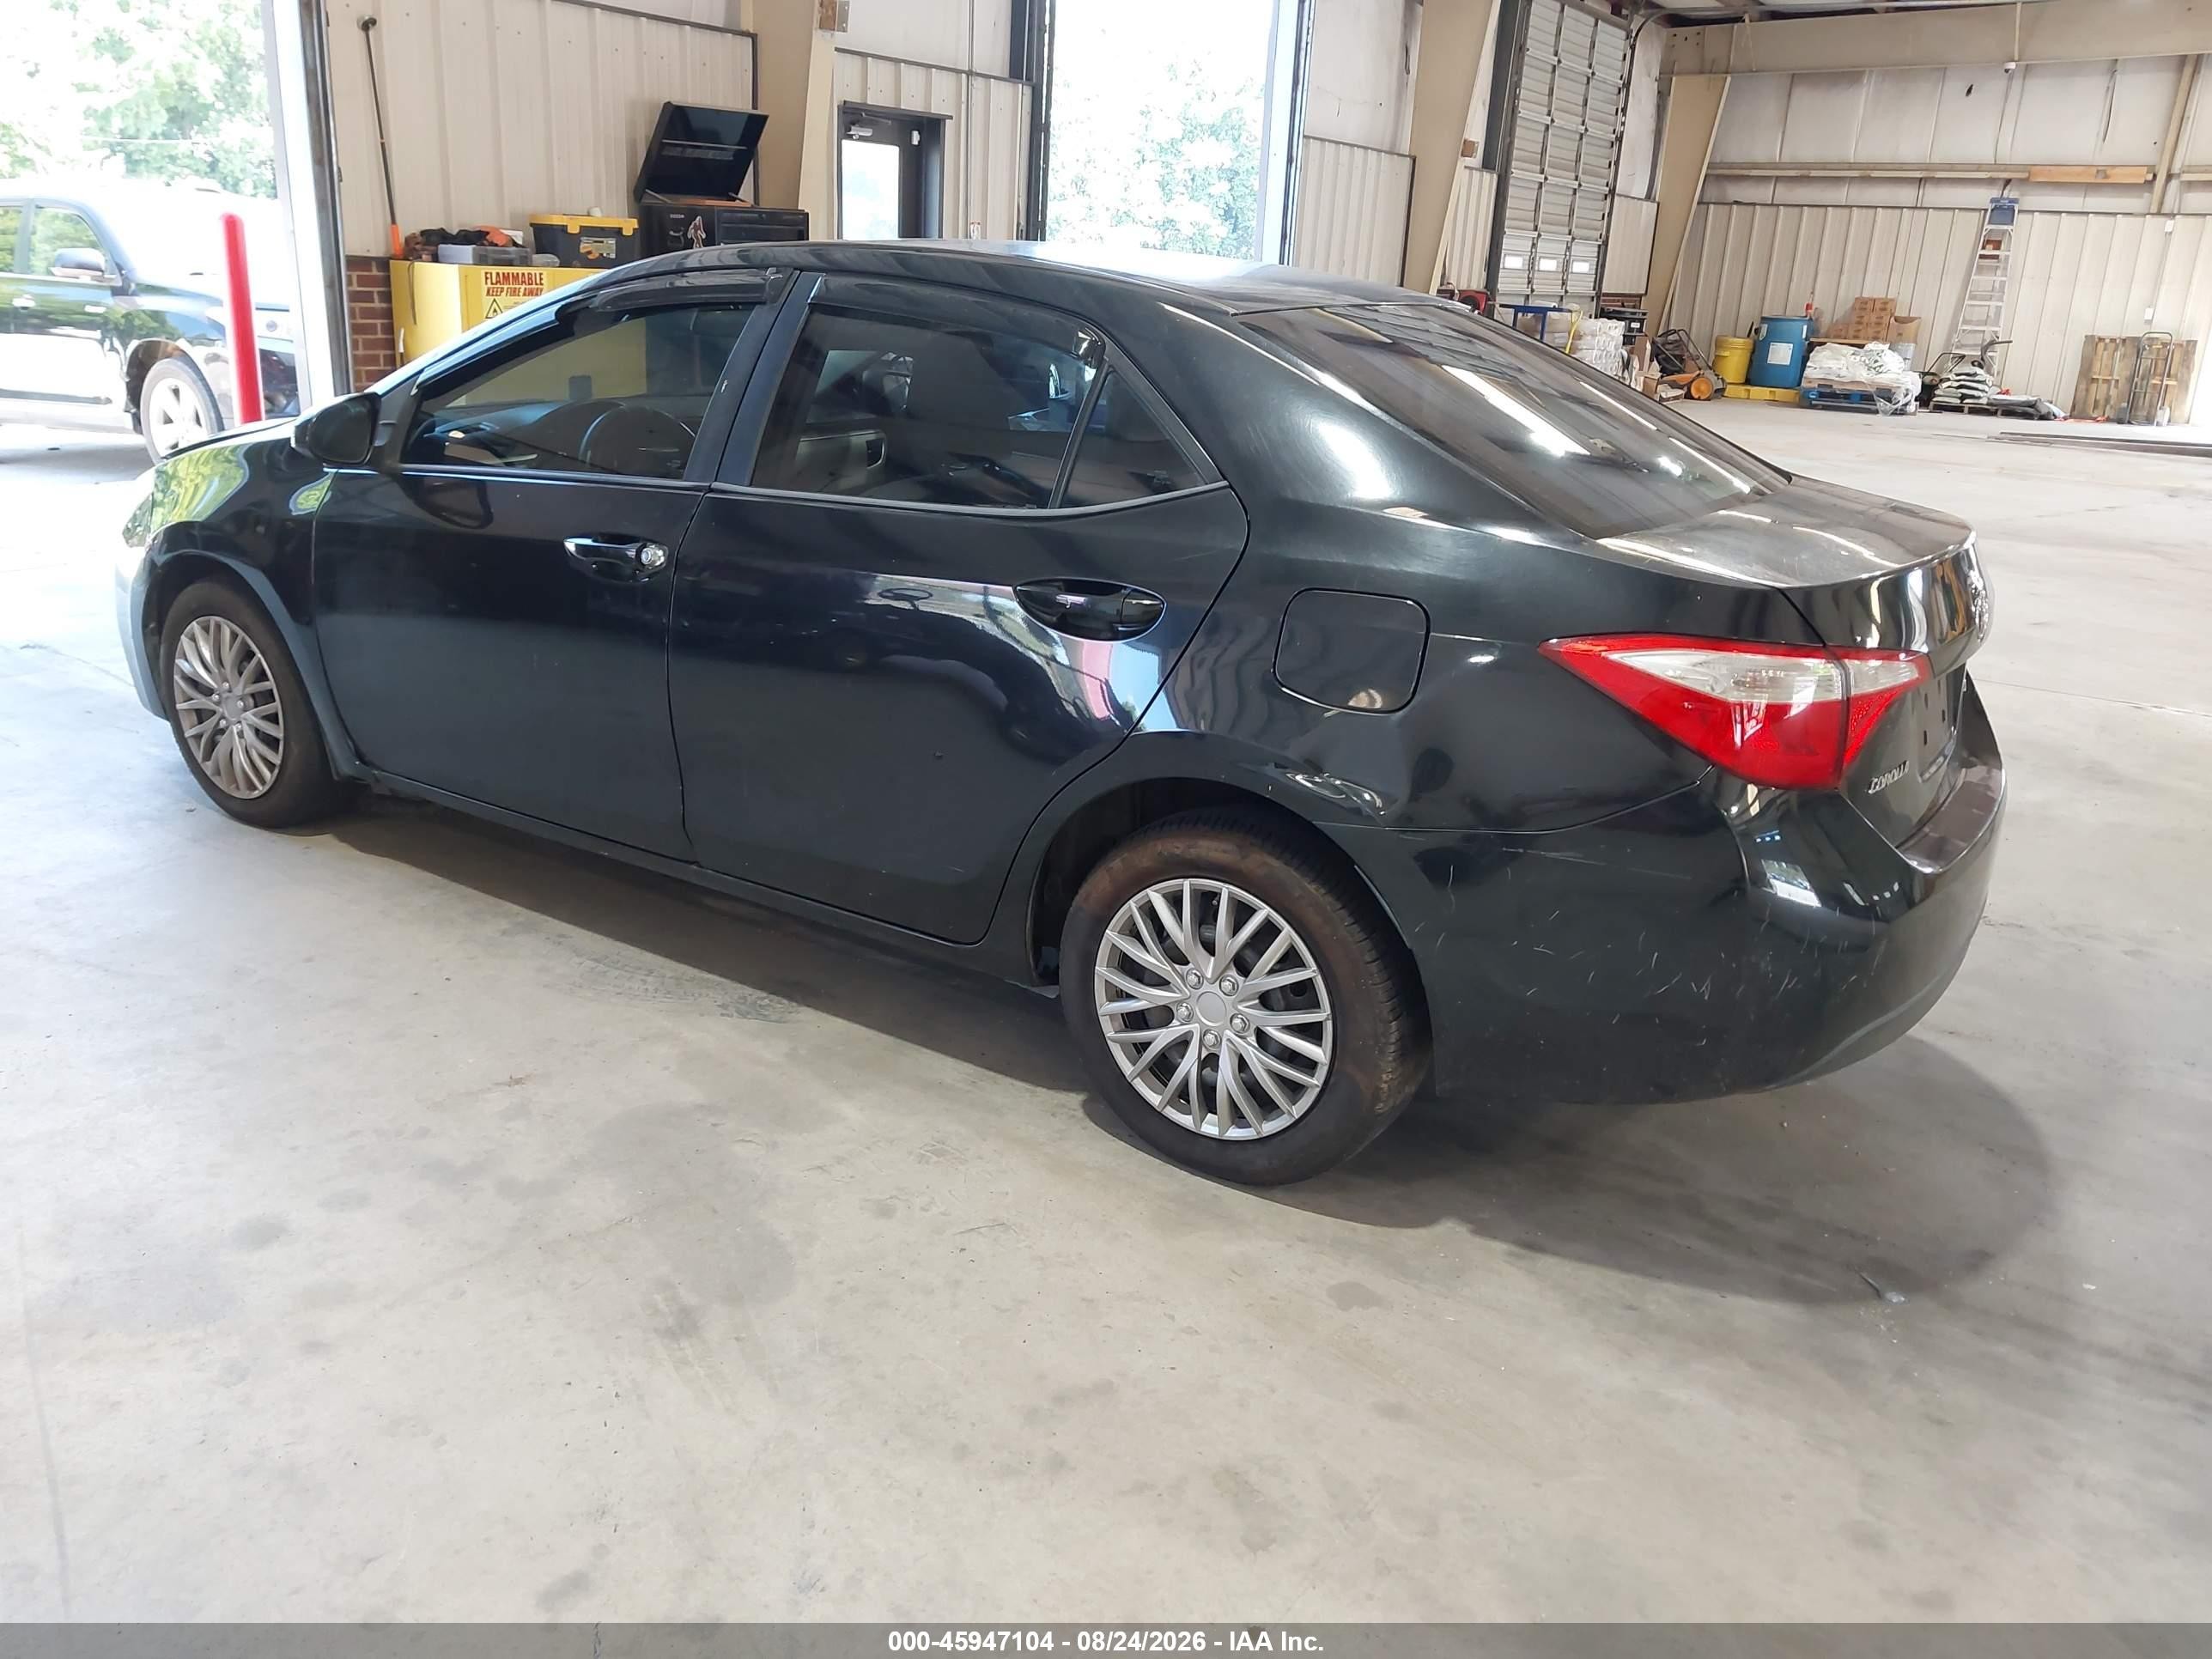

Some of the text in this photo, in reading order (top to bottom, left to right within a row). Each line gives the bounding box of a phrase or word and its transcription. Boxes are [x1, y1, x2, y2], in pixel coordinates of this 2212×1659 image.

[484, 271, 544, 286] FLAMMABLE
[486, 287, 544, 297] KEEP FIRE AWAY
